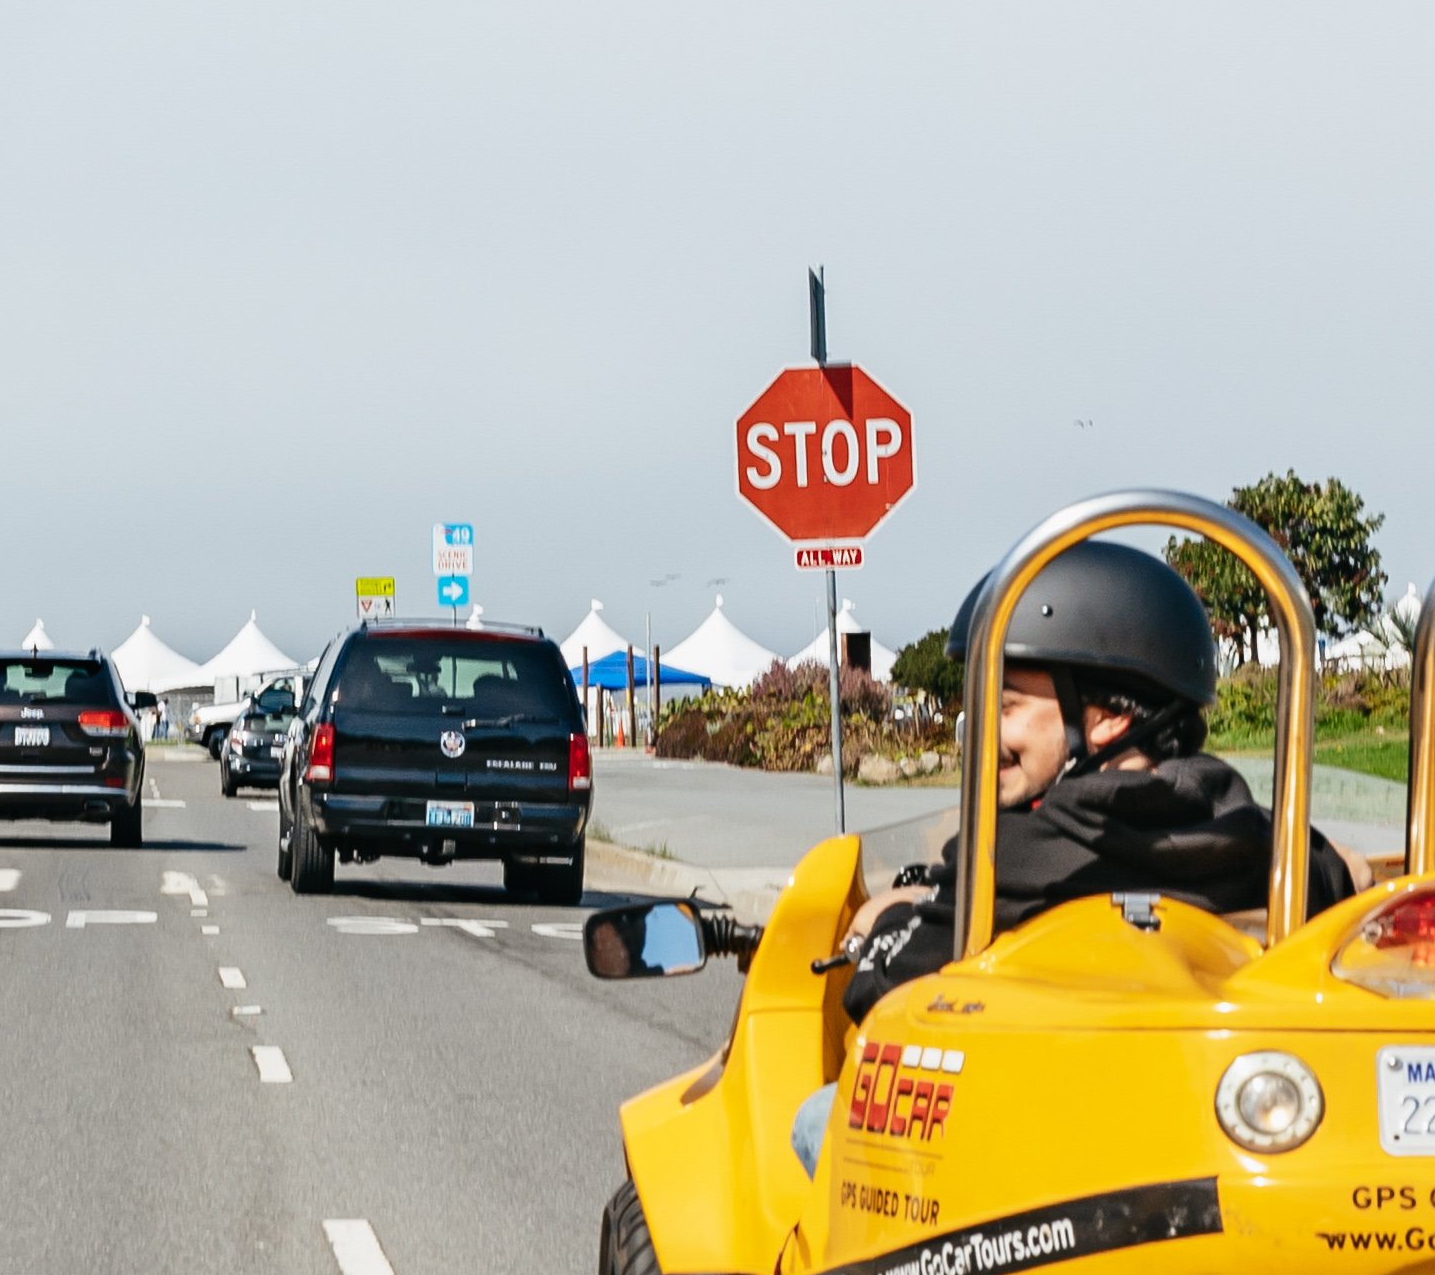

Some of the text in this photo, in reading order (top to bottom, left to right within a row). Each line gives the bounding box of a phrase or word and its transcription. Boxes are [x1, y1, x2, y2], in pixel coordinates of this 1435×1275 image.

[746, 417, 903, 490] STOP
[452, 526, 470, 544] 49
[437, 561, 467, 572] DRIVE
[801, 549, 858, 567] ALL WAY
[21, 707, 44, 720] Jeep
[326, 915, 584, 941] STO
[841, 1180, 940, 1226] GPS GUIDED TOUR
[1352, 1186, 1417, 1210] GPS
